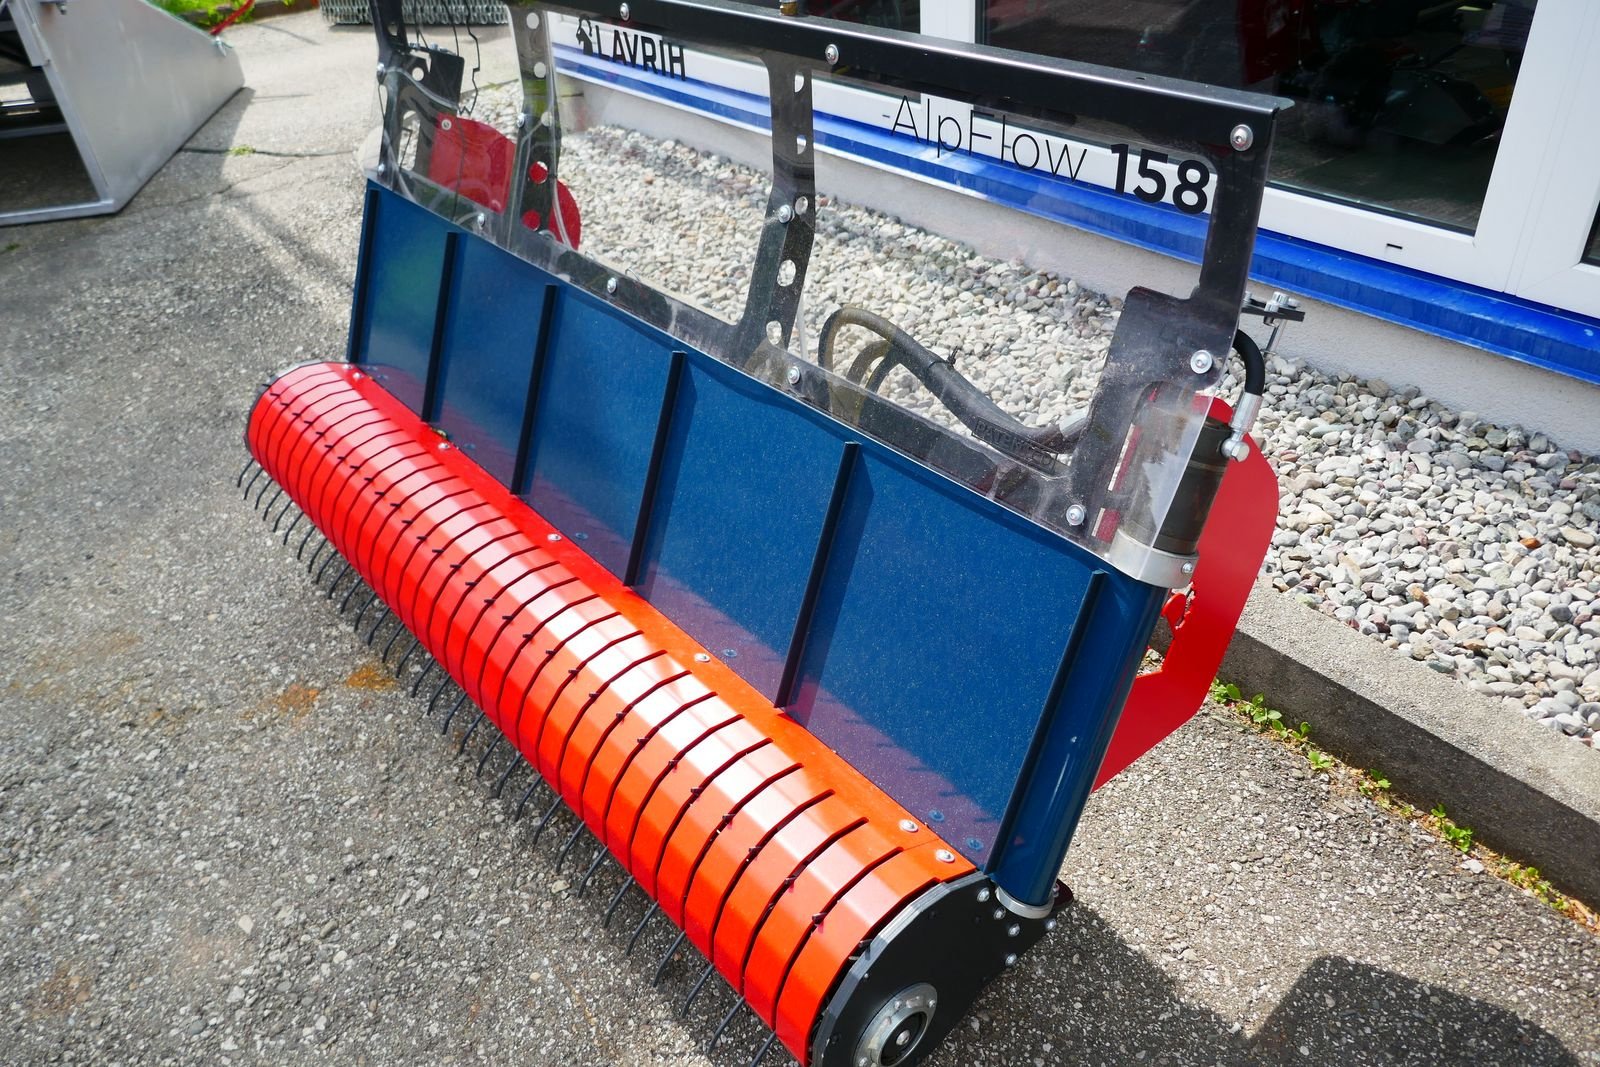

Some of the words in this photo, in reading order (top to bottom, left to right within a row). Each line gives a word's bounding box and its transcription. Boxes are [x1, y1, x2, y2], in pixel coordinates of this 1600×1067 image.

[595, 25, 686, 81] LAVRIH
[889, 95, 1087, 182] AlpFlow
[1110, 143, 1210, 214] 158
